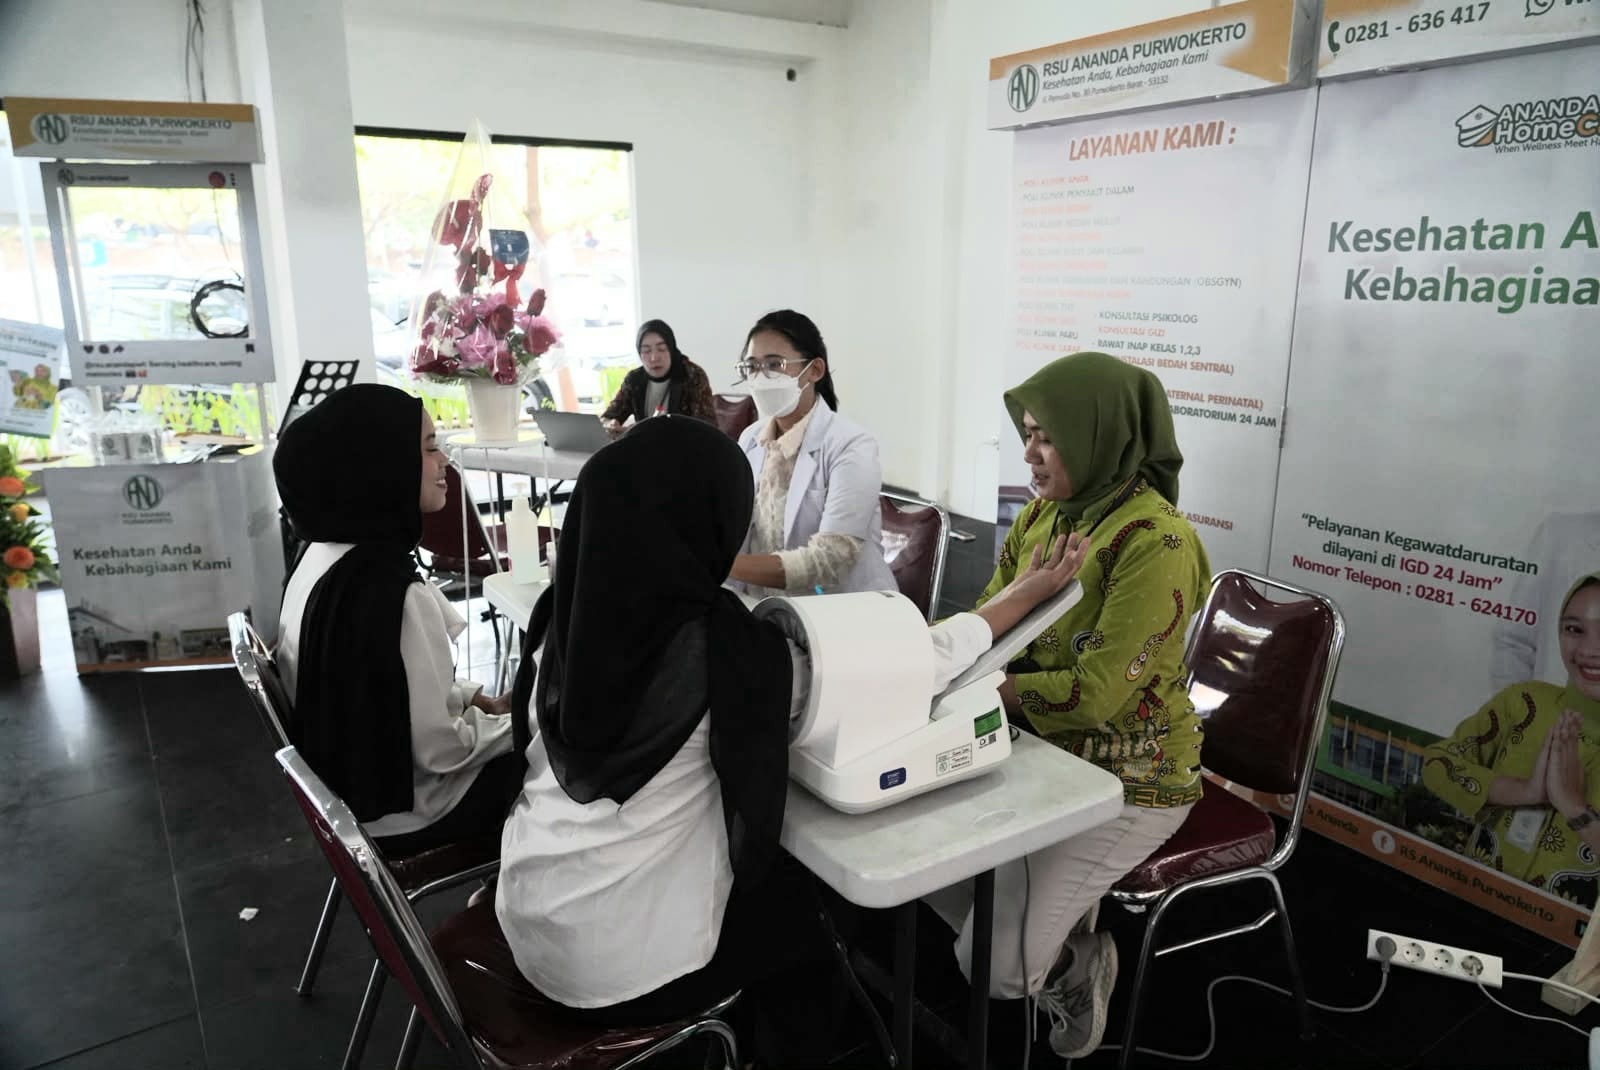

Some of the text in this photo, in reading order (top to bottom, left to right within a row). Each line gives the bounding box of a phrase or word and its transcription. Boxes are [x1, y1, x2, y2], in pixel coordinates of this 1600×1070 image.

[1345, 20, 1389, 44] 0281
[1408, 10, 1444, 33] 636
[1450, 2, 1490, 26] 417
[1042, 22, 1246, 77] RSU ANANDA PURWOKERTO
[1042, 50, 1209, 91] Kesehatan Anda, Kebahagiaan Kami
[1497, 95, 1600, 122] ANANDA
[70, 115, 232, 130] RSU ANANDA PURWOKERTO
[1494, 113, 1600, 145] HomeC
[1069, 128, 1158, 162] LAYANAN
[1162, 121, 1224, 151] KAMI
[1495, 144, 1520, 154] When
[1522, 140, 1562, 152] Wellness
[1564, 138, 1589, 149] Meet
[1327, 215, 1546, 253] Kesehatan
[1099, 311, 1198, 324] KONSULTASI PSIKOLOG
[1097, 338, 1201, 356] RAWAT INAP KELAS 1,2,3
[1157, 357, 1188, 369] BEDAH
[1190, 361, 1235, 376] SENTRAL)
[1167, 388, 1264, 411] ATERNAL PERINATAL)
[1169, 404, 1277, 428] ABORATORIUM 24 JAM
[1186, 511, 1233, 531] ASURANSI
[73, 543, 203, 561] Kesehatan Anda
[1322, 540, 1378, 565] dilayani
[1381, 553, 1396, 569] di
[1399, 556, 1429, 576] IGD
[1433, 563, 1454, 582] 24
[1384, 530, 1539, 575] Kegawatdaruratan
[85, 557, 232, 577] Kebahagiaan Kami
[1292, 554, 1341, 577] Nomor
[1345, 567, 1401, 592] Telepon
[1415, 582, 1454, 607] 0281
[1470, 597, 1537, 627] 624170
[1399, 846, 1555, 923] RS Ananda Purwokerto
